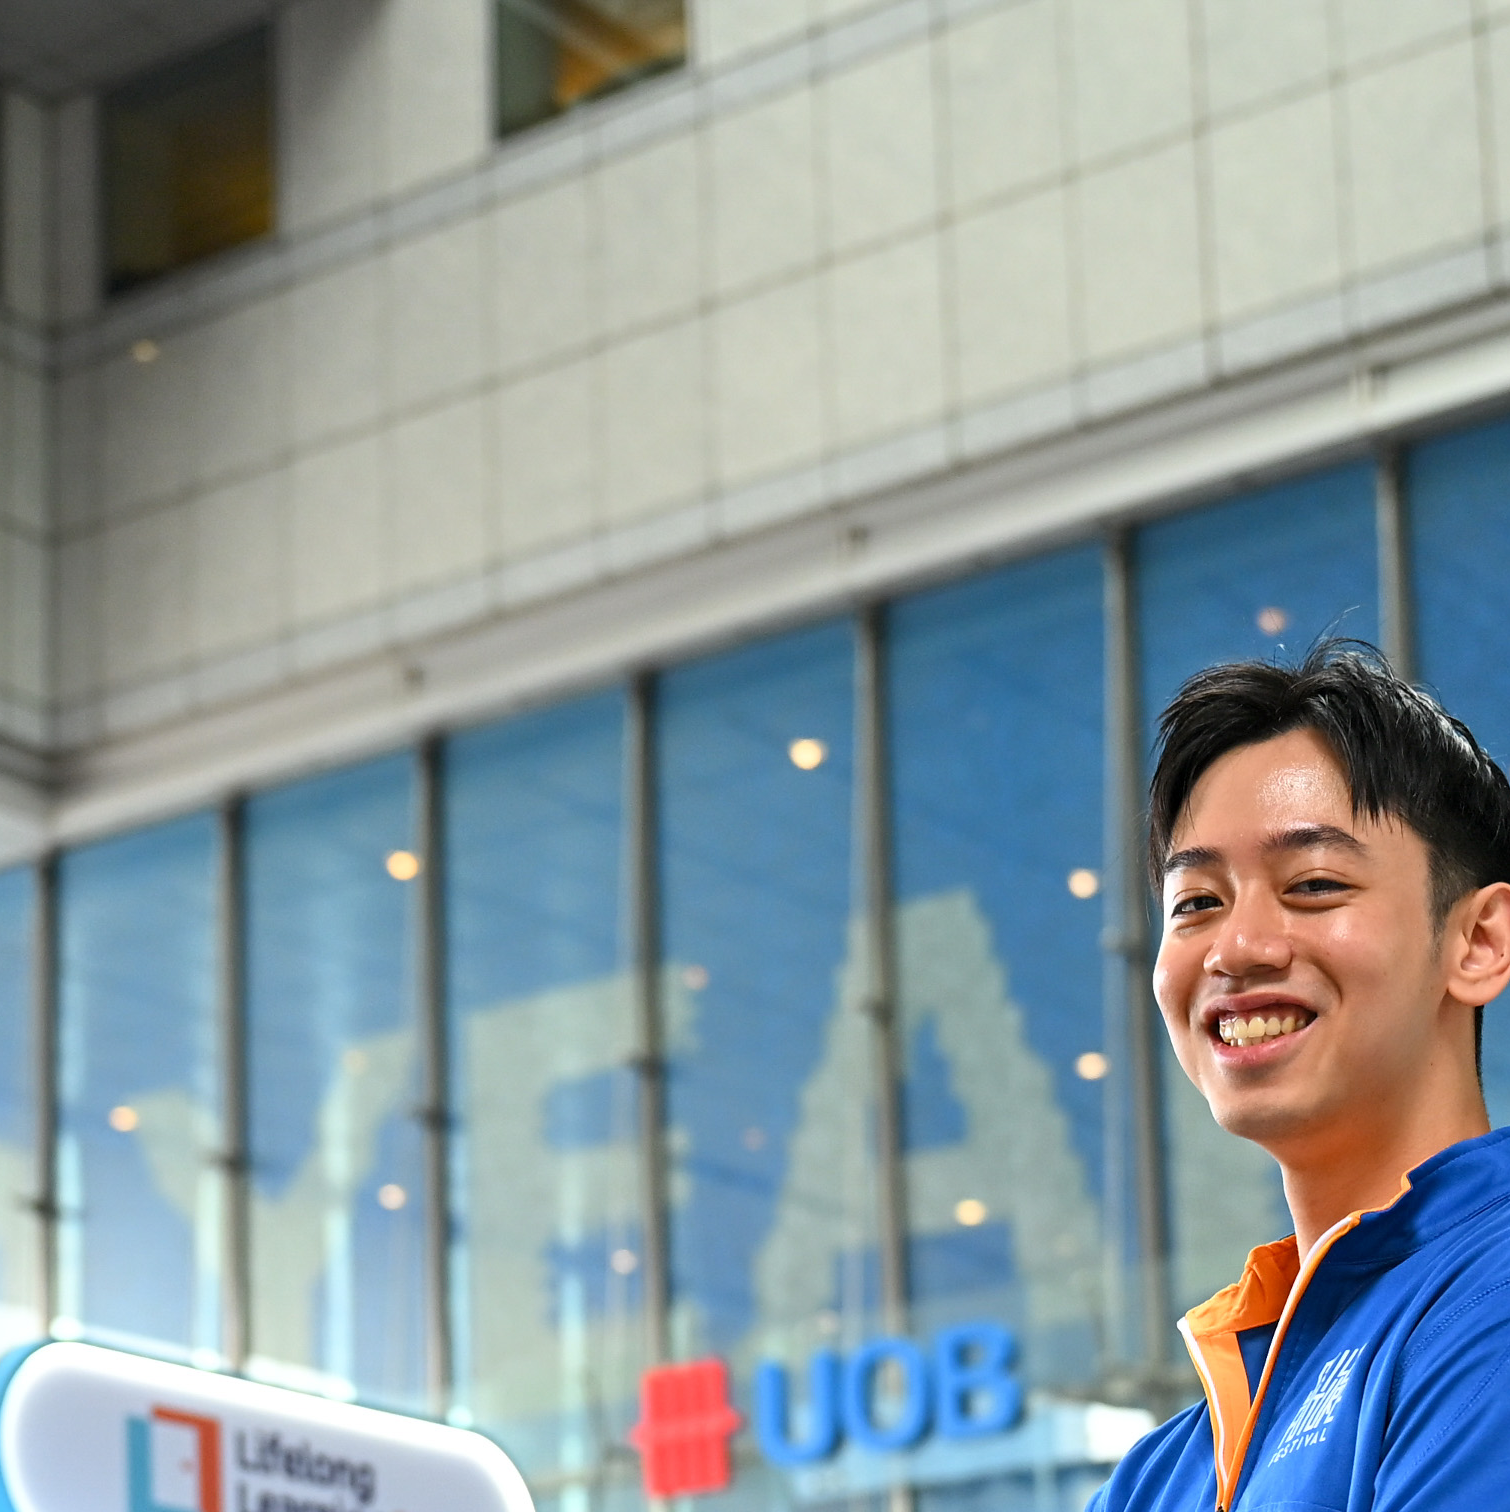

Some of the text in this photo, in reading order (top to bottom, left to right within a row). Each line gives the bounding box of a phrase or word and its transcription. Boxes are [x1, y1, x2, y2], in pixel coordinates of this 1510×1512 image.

[753, 1322, 1022, 1468] UOB
[238, 1431, 376, 1506] Lifelong
[1268, 1428, 1327, 1467] FESTIVAL
